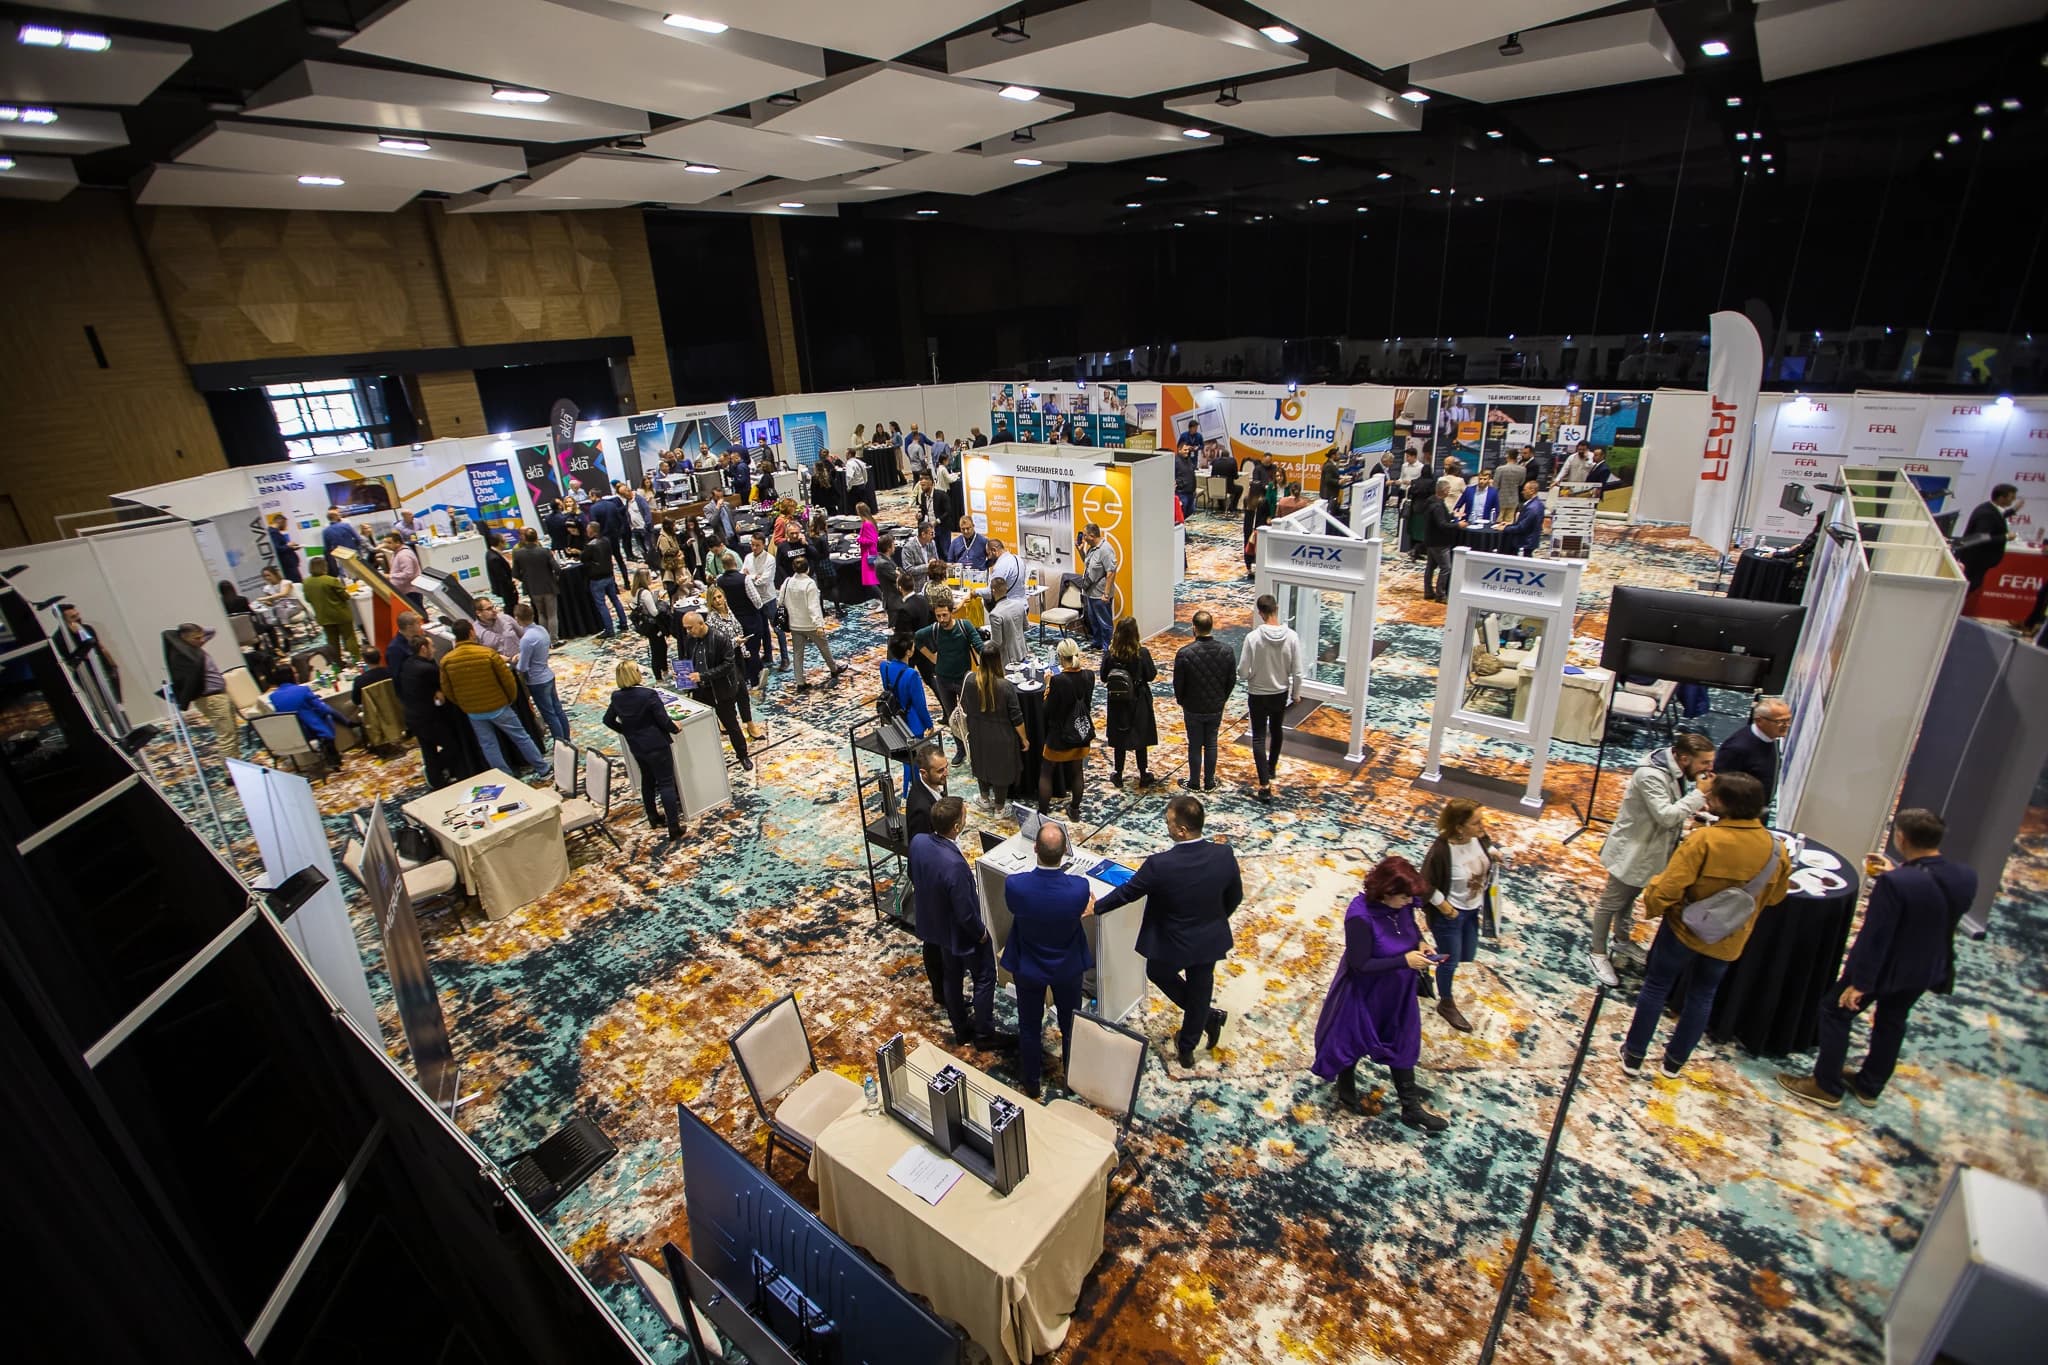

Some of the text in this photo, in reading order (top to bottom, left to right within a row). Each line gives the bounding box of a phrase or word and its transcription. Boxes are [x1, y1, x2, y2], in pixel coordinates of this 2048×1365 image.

[1240, 422, 1335, 443] Kömmerling
[1868, 424, 1897, 433] FEAL
[1700, 395, 1738, 481] FEAL
[1791, 442, 1818, 451] FEAL
[1939, 448, 1968, 457] FEAL
[1295, 463, 1322, 473] SUTR
[1794, 459, 1817, 467] FEAL
[1904, 464, 1929, 472] FEAL
[1016, 464, 1059, 475] SCHACHERMAYER
[254, 472, 293, 484] THREE
[470, 471, 498, 479] Three
[472, 477, 505, 487] Brands
[259, 482, 305, 495] BRANDS
[475, 486, 494, 495] One
[1291, 545, 1343, 562] ARX
[1291, 558, 1305, 567] The
[1482, 567, 1548, 588] ARX
[1481, 582, 1545, 598] The Hardware.
